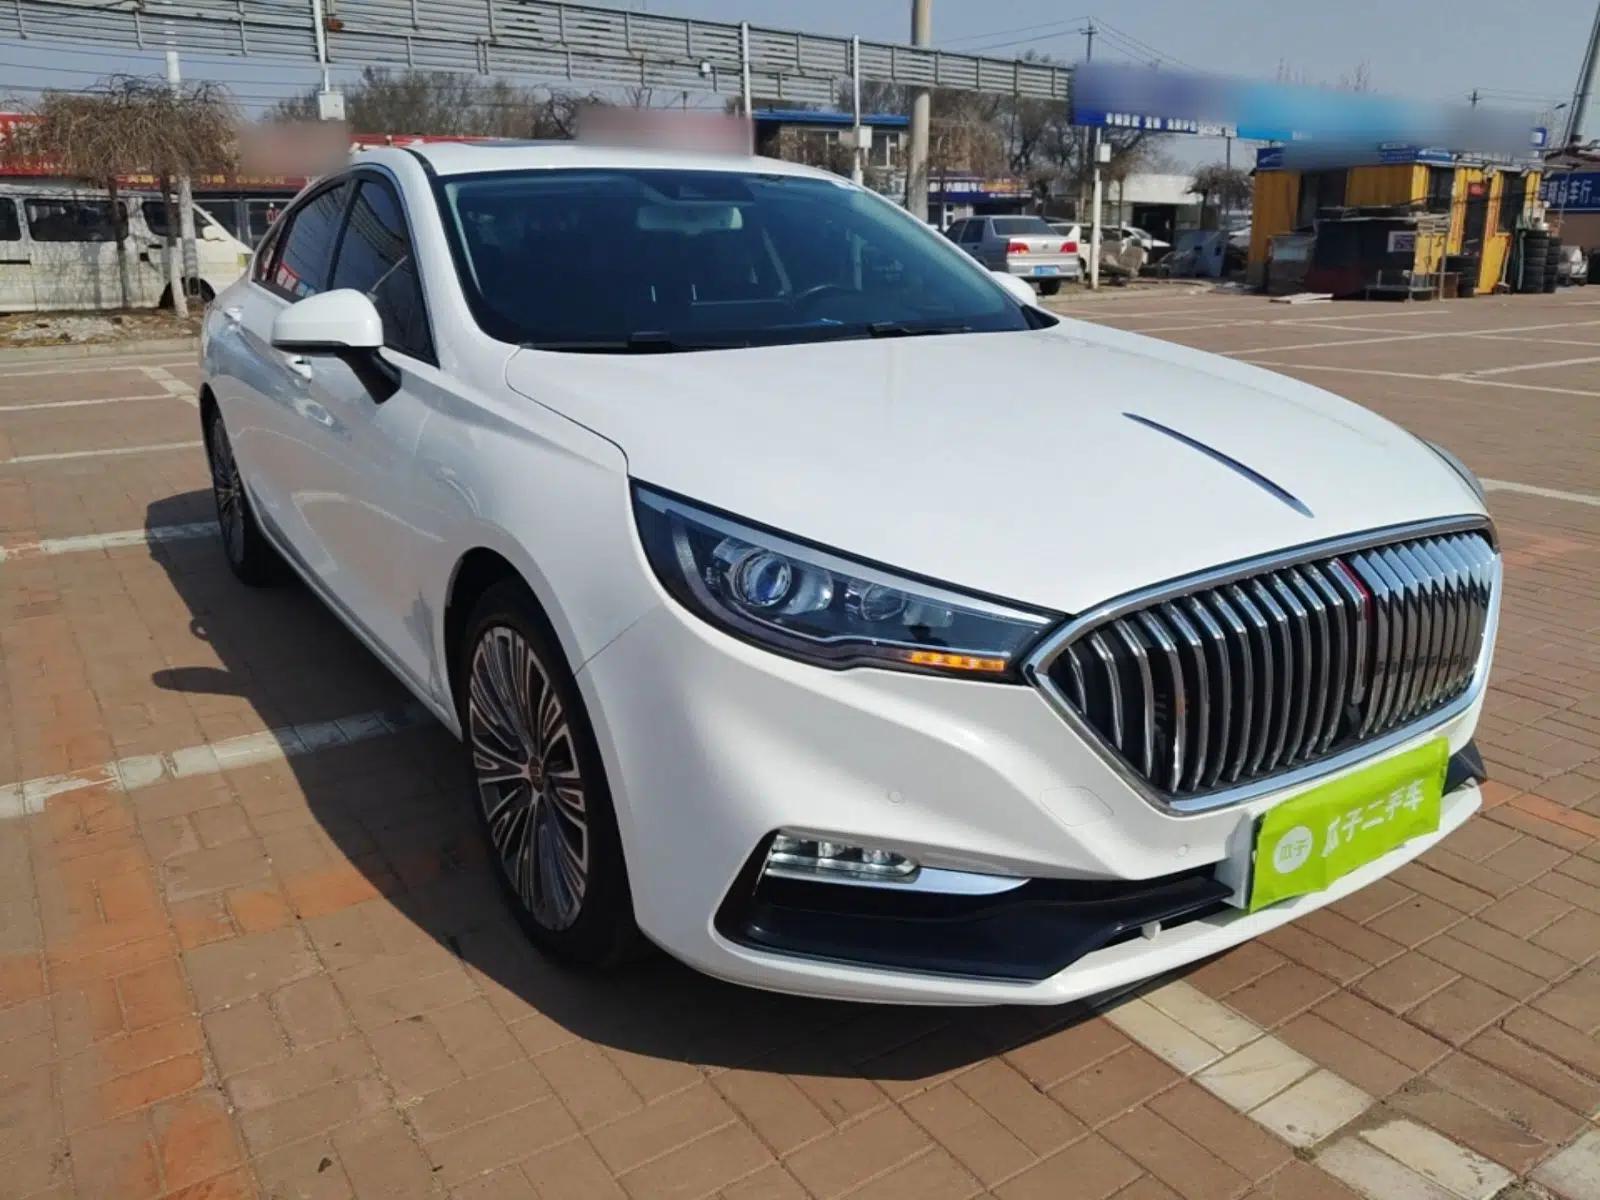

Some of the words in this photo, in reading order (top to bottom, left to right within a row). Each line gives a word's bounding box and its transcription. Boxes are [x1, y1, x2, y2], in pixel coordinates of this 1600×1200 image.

[1321, 779, 1424, 857] 瓜子二手车
